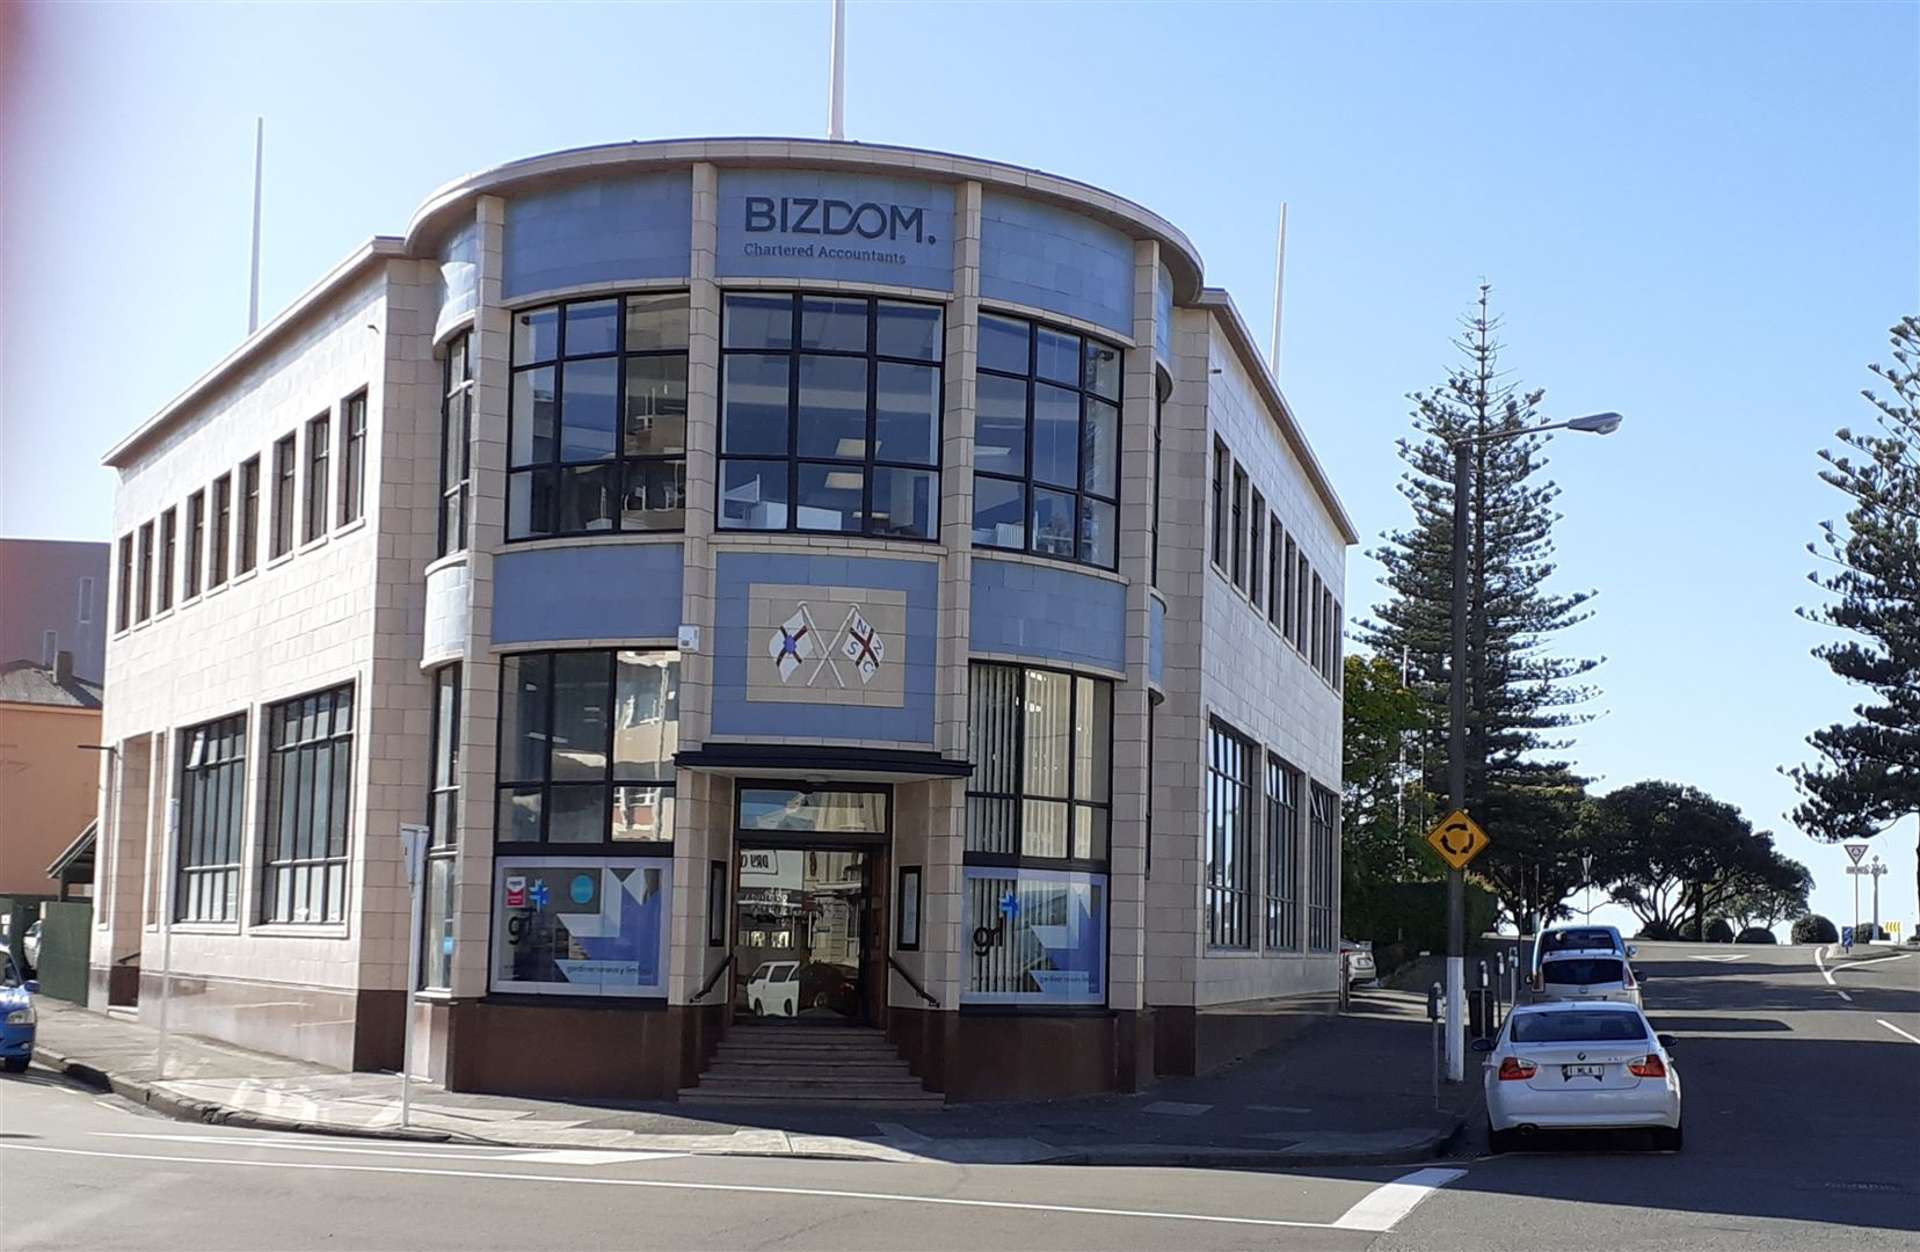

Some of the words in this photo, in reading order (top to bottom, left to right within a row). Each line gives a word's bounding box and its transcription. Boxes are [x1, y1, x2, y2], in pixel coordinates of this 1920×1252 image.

[744, 243, 814, 258] Chartered
[818, 245, 906, 265] Accountants
[857, 619, 867, 635] N
[847, 641, 859, 655] S
[863, 661, 874, 673] C
